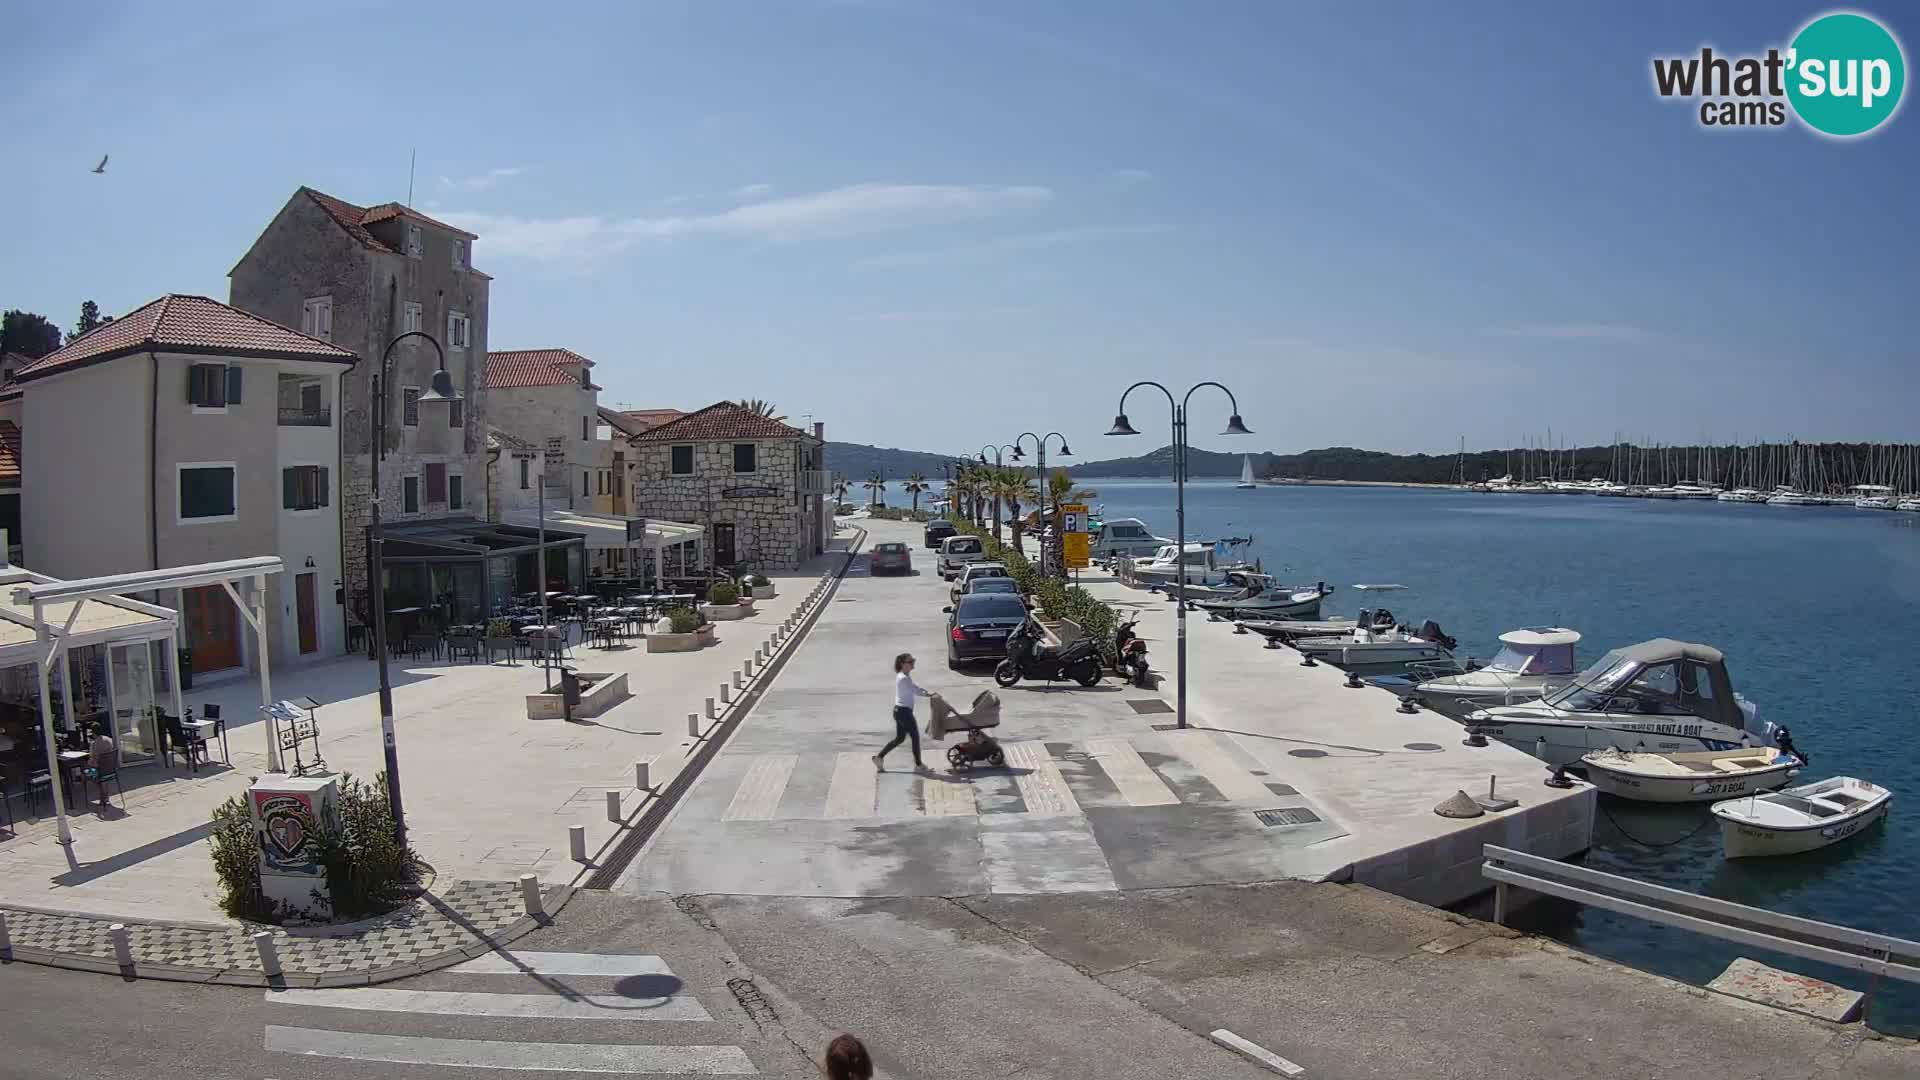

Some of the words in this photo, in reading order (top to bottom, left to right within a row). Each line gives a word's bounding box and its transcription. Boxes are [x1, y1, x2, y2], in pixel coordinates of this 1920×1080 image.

[1066, 514, 1076, 530] P
[1656, 724, 1676, 735] RENT
[1676, 725, 1682, 735] A
[1683, 725, 1703, 737] BOAT
[1728, 781, 1746, 793] BOAT
